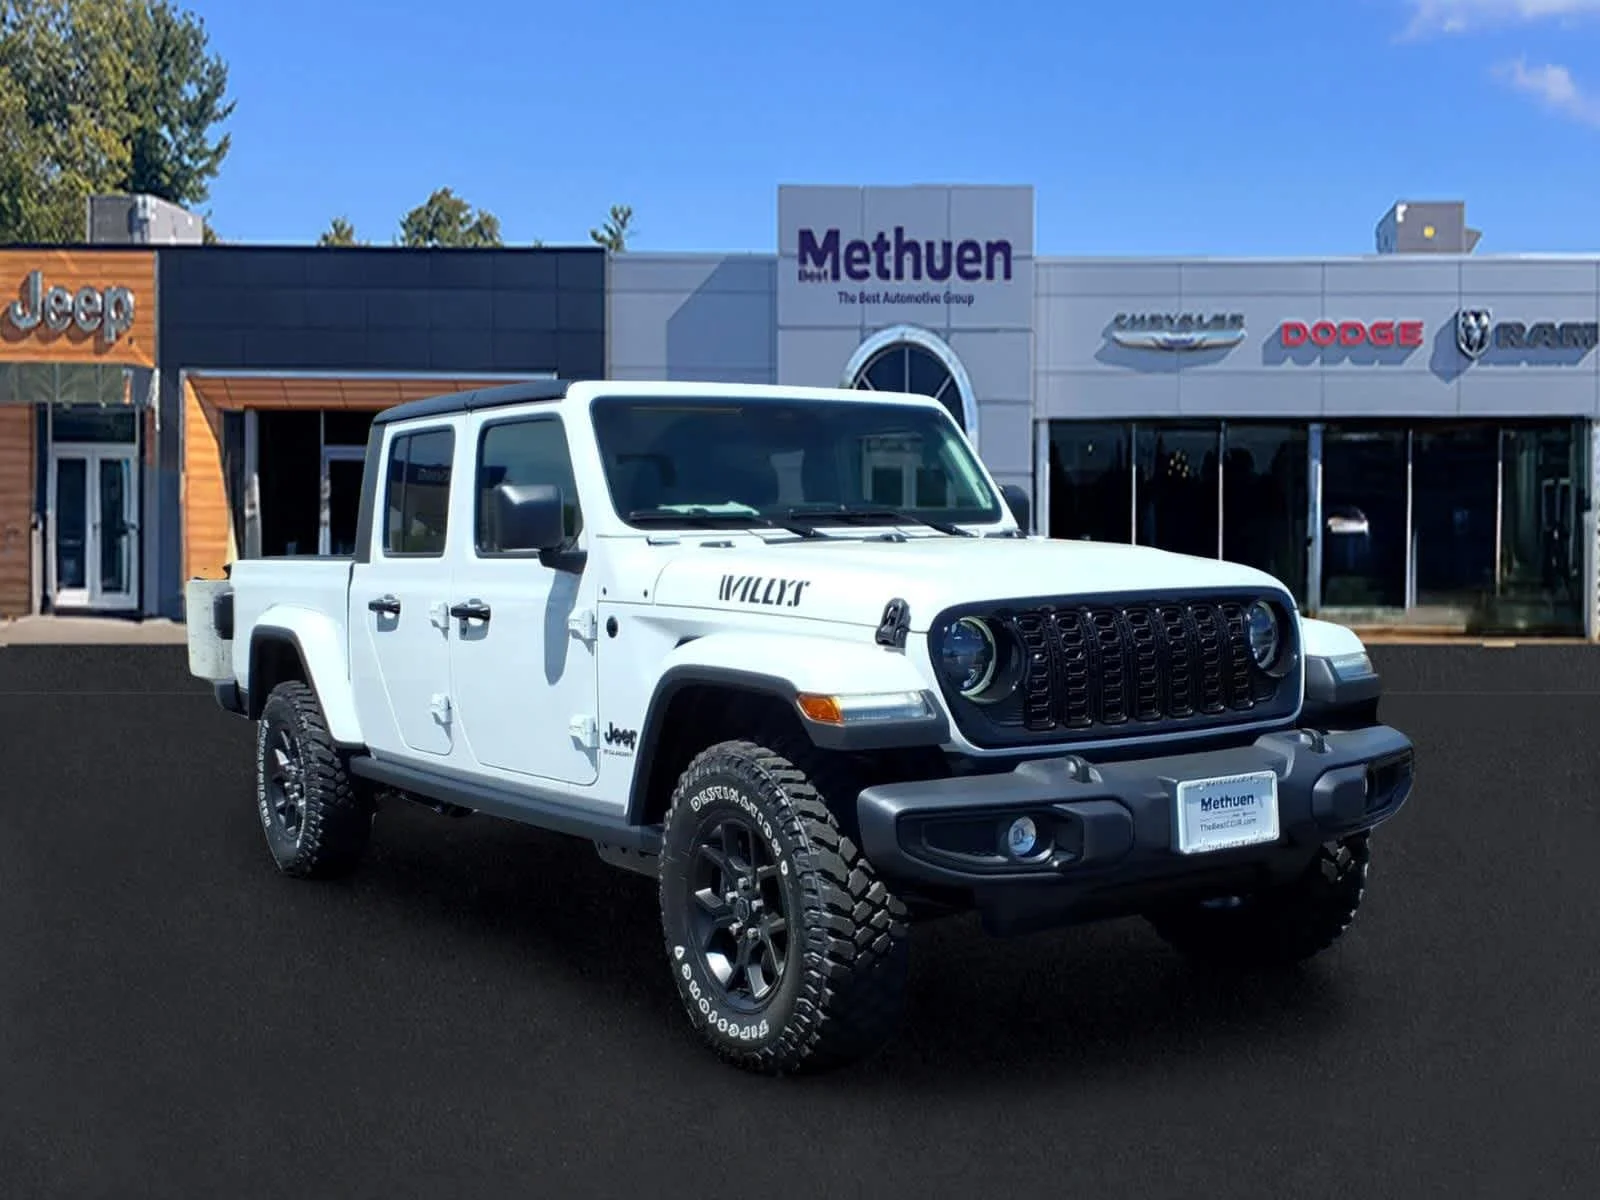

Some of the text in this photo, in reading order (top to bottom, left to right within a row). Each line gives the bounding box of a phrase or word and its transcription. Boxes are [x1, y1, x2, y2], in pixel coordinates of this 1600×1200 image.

[798, 226, 1012, 282] Methuen
[9, 270, 135, 344] Jeep
[838, 291, 975, 307] The Best Automotive Group
[1113, 313, 1245, 329] CHRYSLER
[1281, 321, 1424, 346] DODGE
[1495, 322, 1599, 348] RAM
[719, 574, 811, 607] WILLYS
[604, 721, 637, 751] Jeep
[1201, 794, 1254, 811] Methuen
